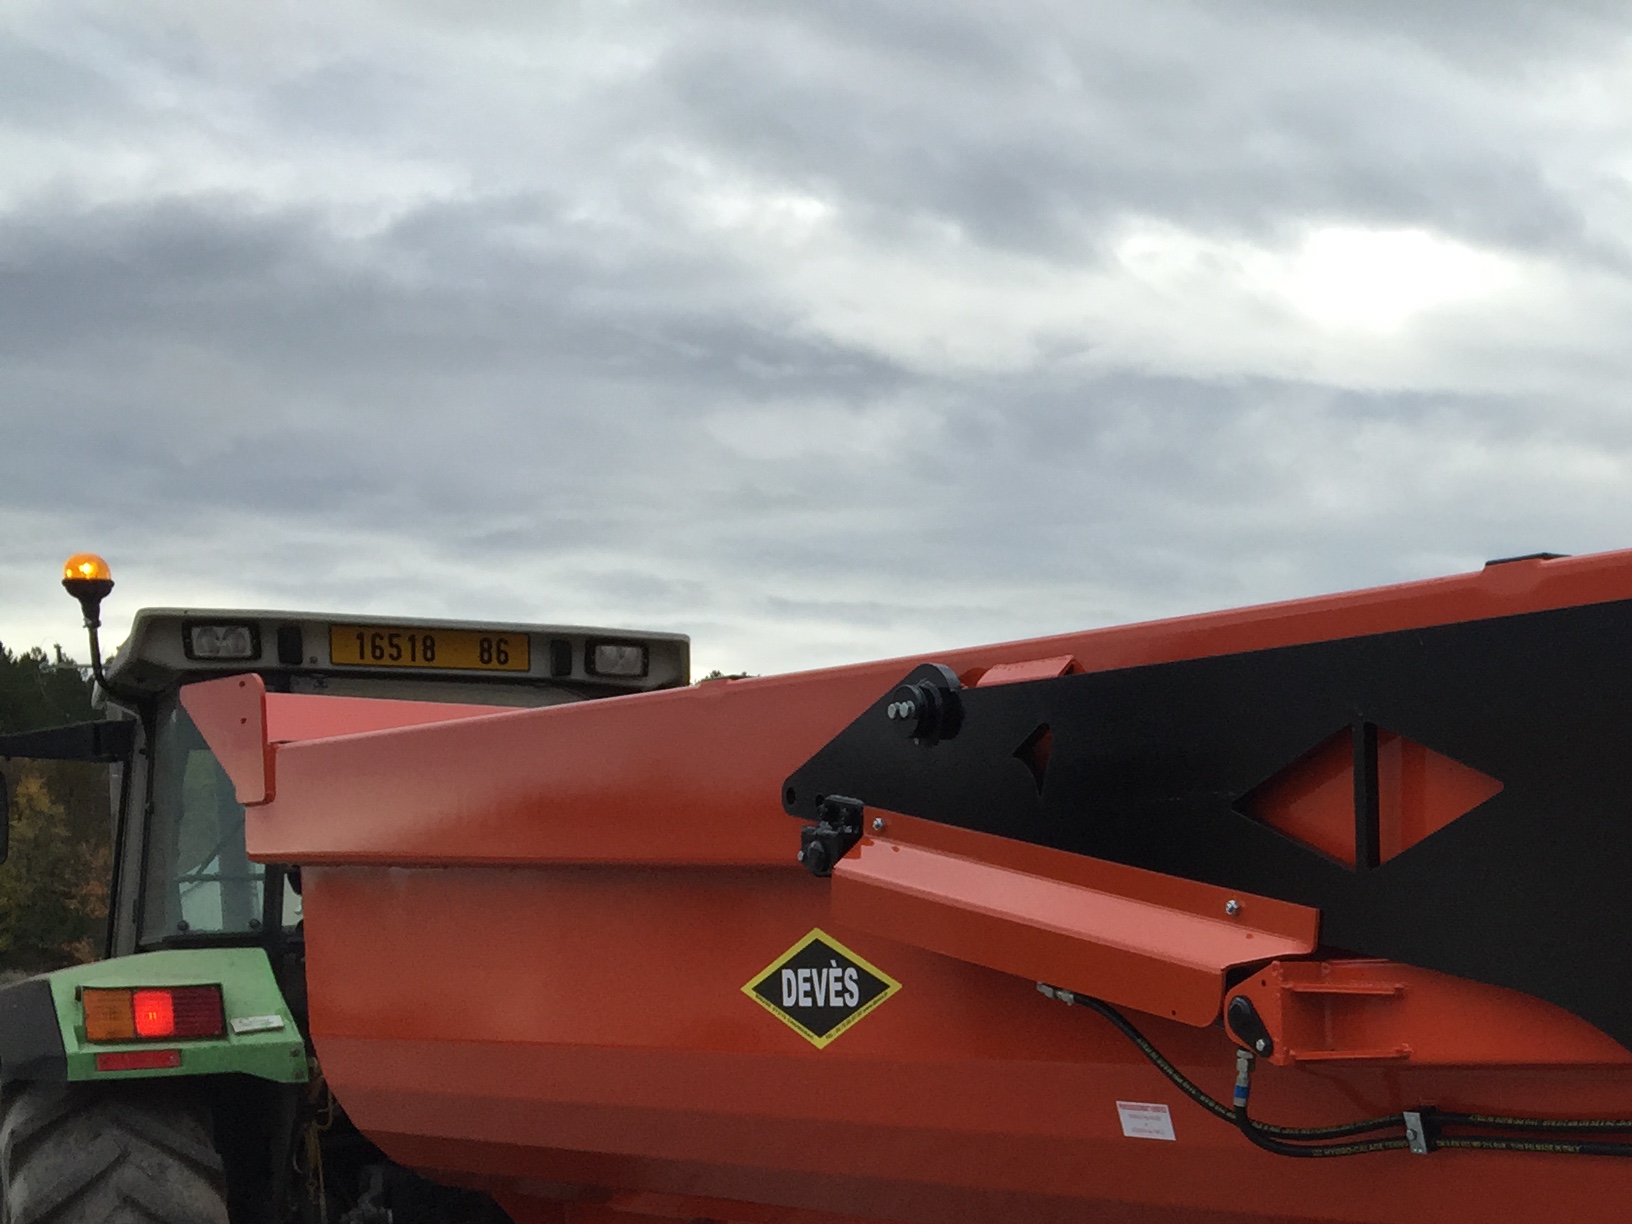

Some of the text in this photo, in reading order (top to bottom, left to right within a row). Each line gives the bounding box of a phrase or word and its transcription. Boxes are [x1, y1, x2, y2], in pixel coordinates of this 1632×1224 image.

[356, 632, 509, 665] 16518 86
[781, 959, 860, 1008] DEVÈS
